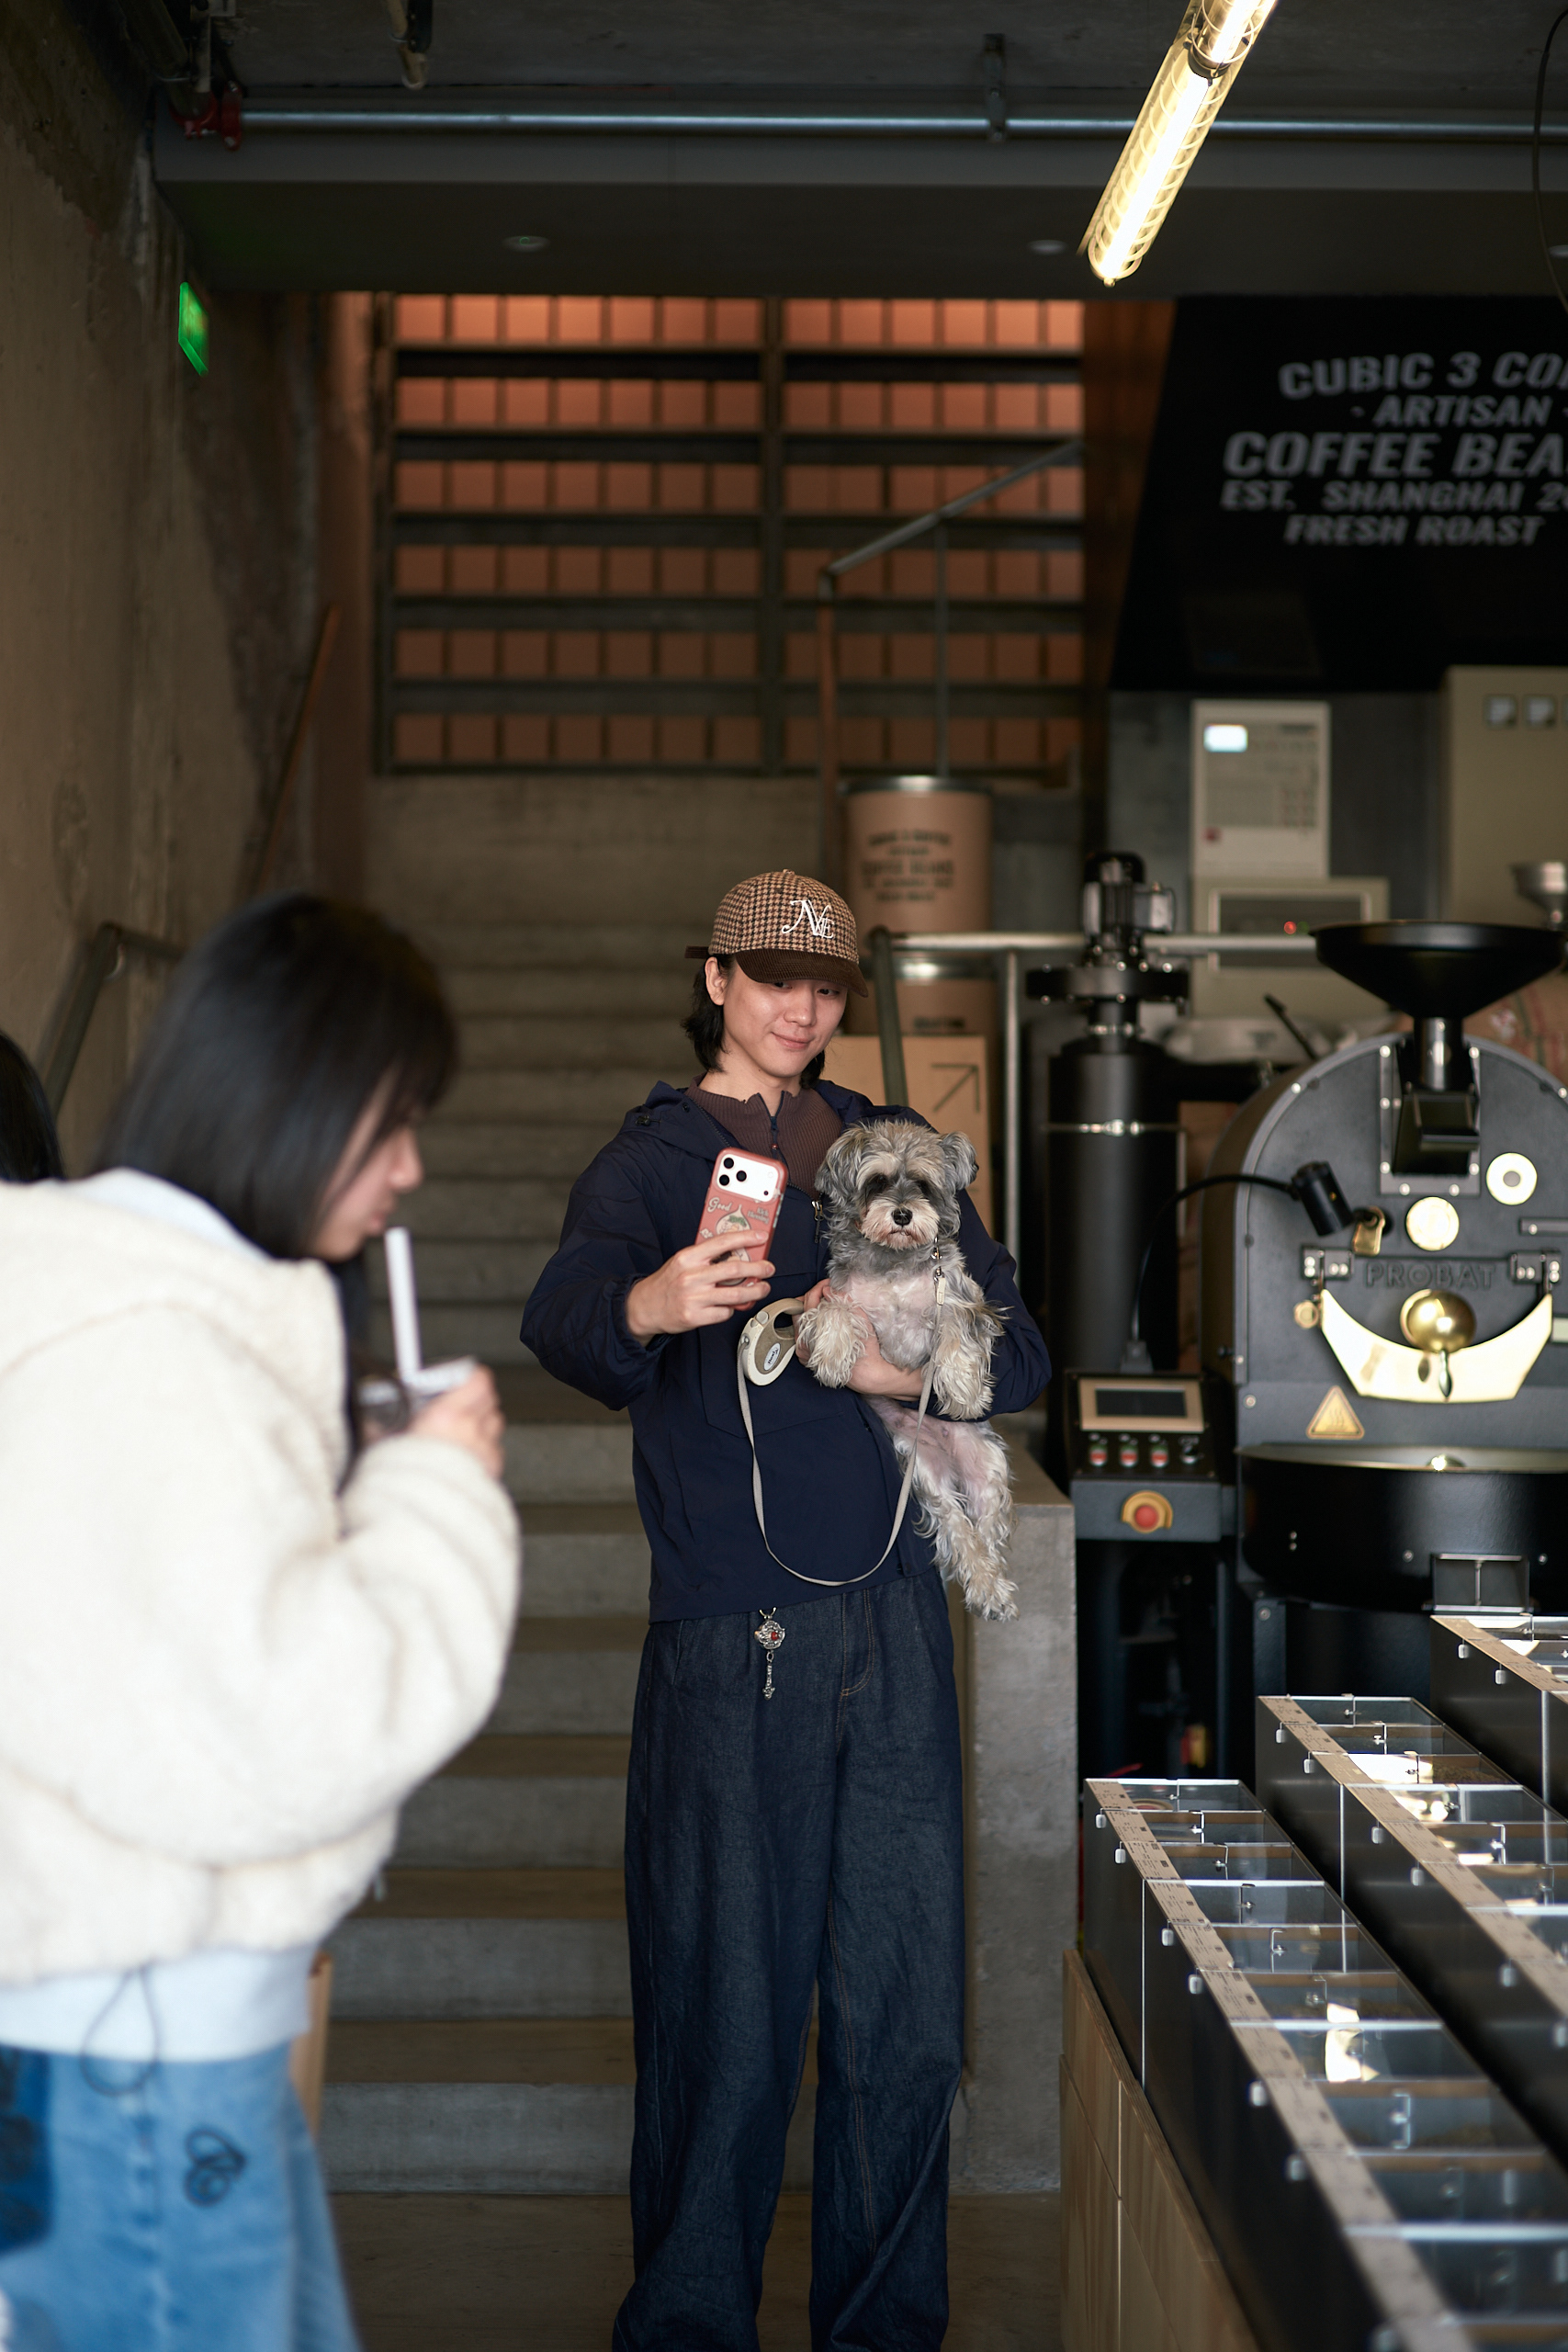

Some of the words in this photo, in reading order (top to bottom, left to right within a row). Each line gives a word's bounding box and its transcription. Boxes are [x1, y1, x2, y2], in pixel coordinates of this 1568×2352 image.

[1279, 353, 1435, 400] CUBIC
[1447, 351, 1481, 388] 3
[1494, 353, 1568, 388] CO
[1374, 396, 1551, 425] ARTISAN
[1224, 433, 1438, 476] COFFEE
[1453, 434, 1568, 476] BEA
[1221, 480, 1296, 511] EST.
[1324, 481, 1522, 509] SHANGHAI
[1285, 514, 1408, 545] FRESH
[1416, 515, 1545, 544] ROAST
[707, 1197, 733, 1213] Good
[1365, 1260, 1496, 1289] PROBAT
